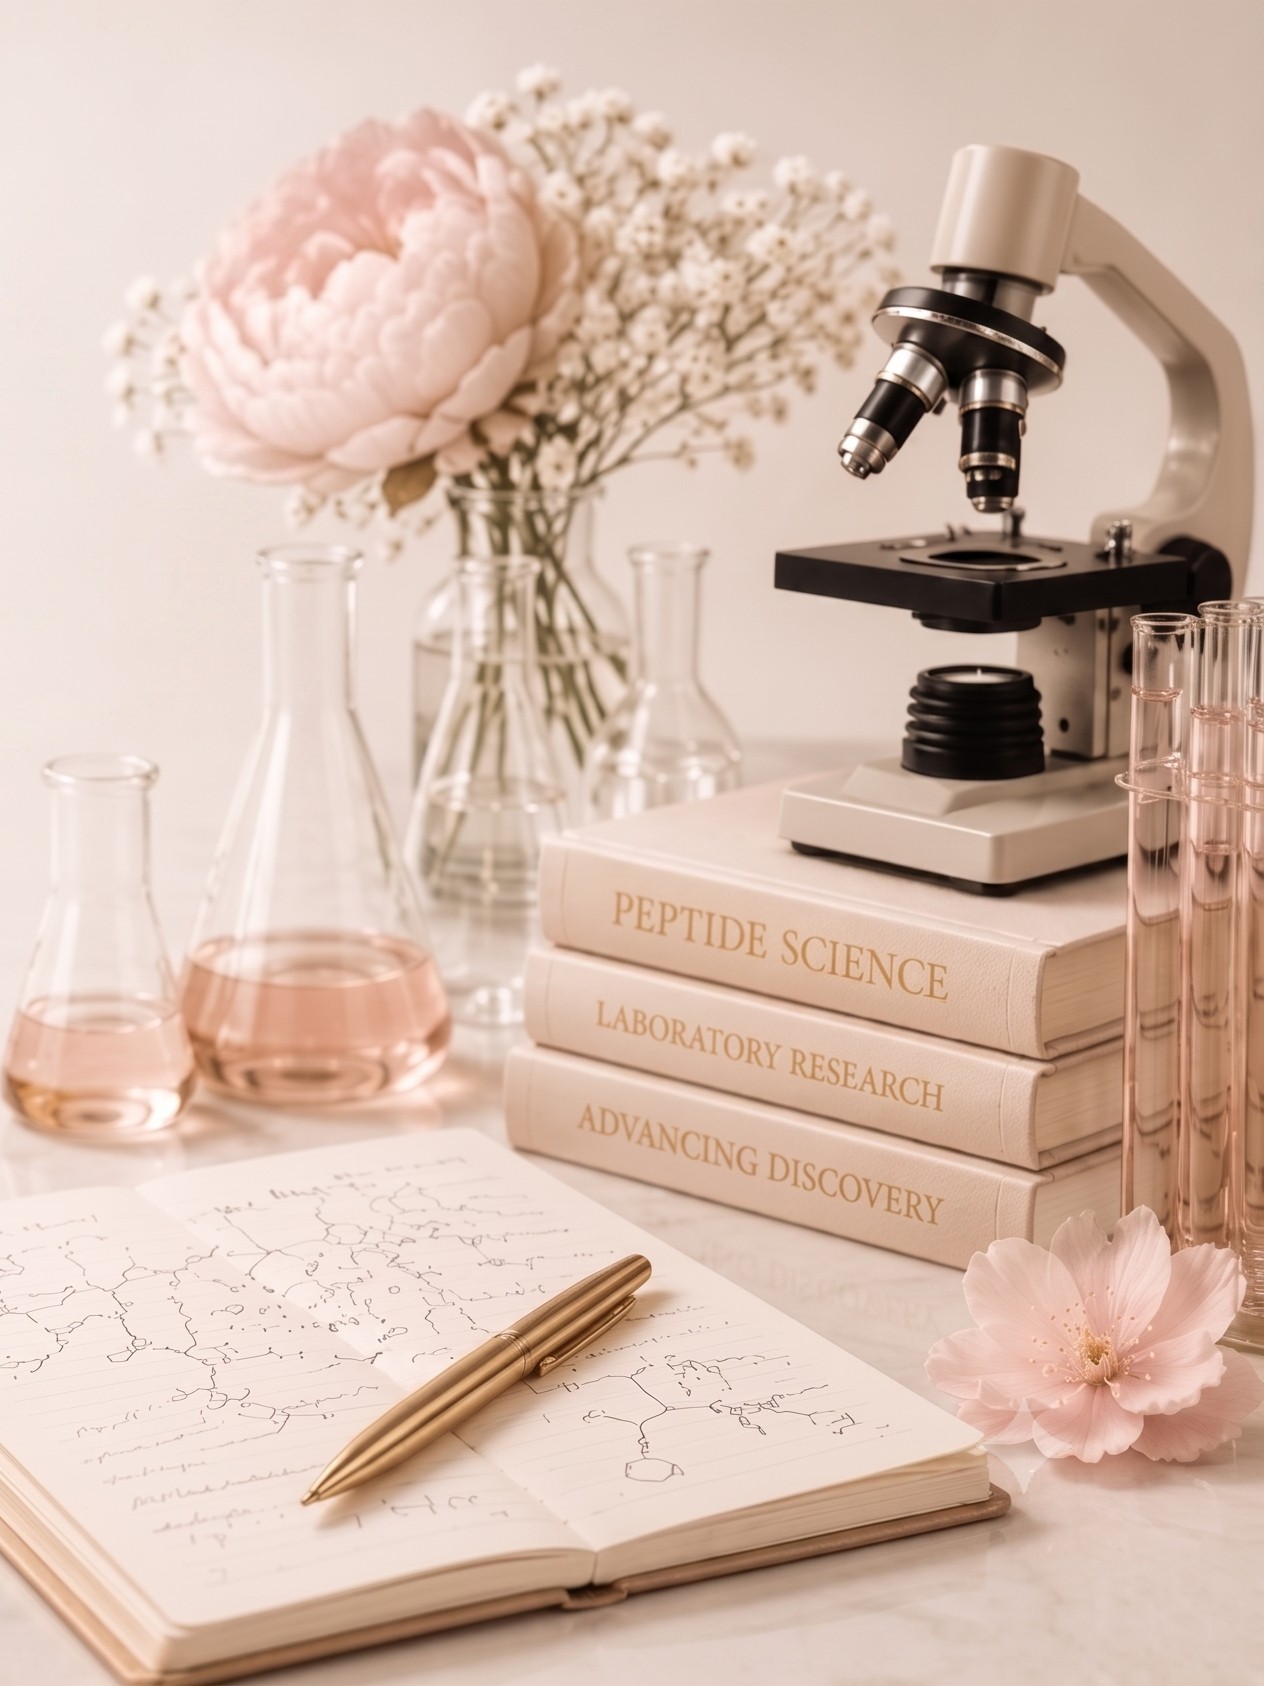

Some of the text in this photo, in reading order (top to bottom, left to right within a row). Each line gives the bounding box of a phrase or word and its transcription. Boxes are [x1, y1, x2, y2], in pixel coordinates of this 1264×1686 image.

[612, 891, 950, 1001] PEPTIDE SCIENCE
[596, 1000, 945, 1112] LABORATORY RESEARCH
[577, 1103, 945, 1227] ADVANCING DISCOVERY
